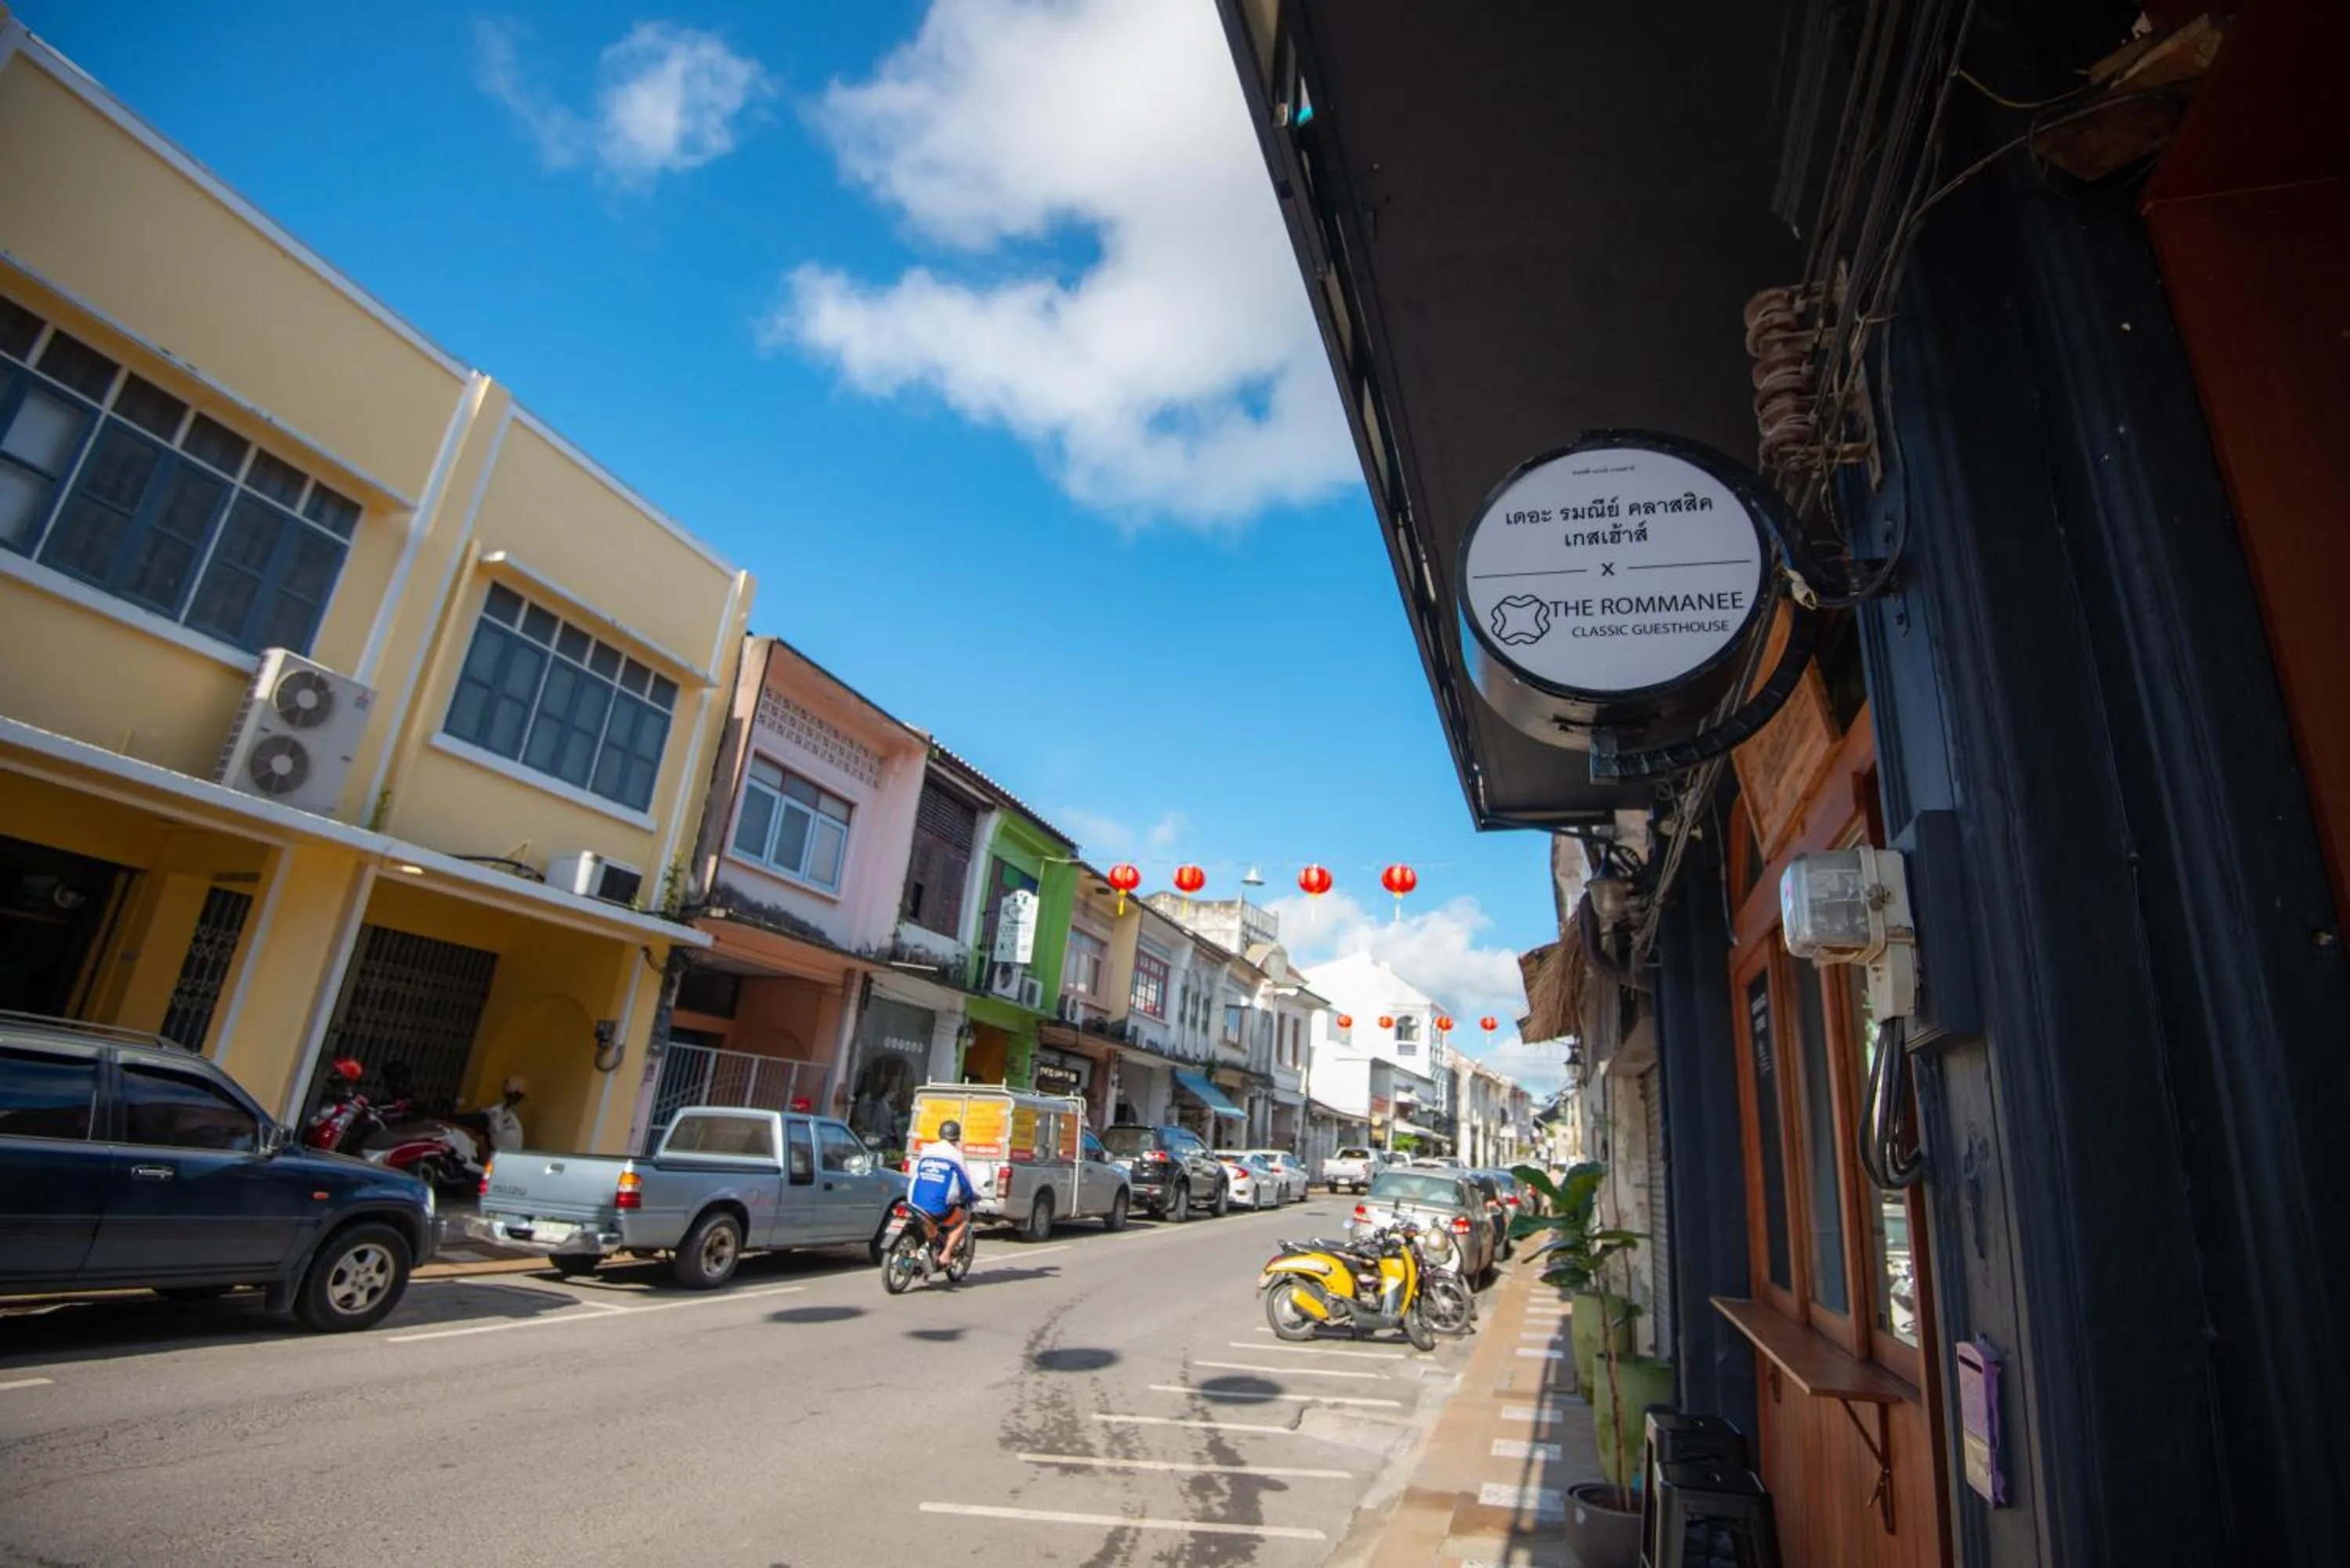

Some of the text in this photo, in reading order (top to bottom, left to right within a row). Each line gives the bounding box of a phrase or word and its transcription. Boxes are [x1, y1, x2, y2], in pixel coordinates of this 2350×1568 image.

[1506, 491, 1713, 526] เดอะ รมณีย์ คลาสสิค
[1549, 591, 1744, 618] THE ROMMANEE
[1572, 619, 1730, 638] CLASSIC GUESTHOUSE
